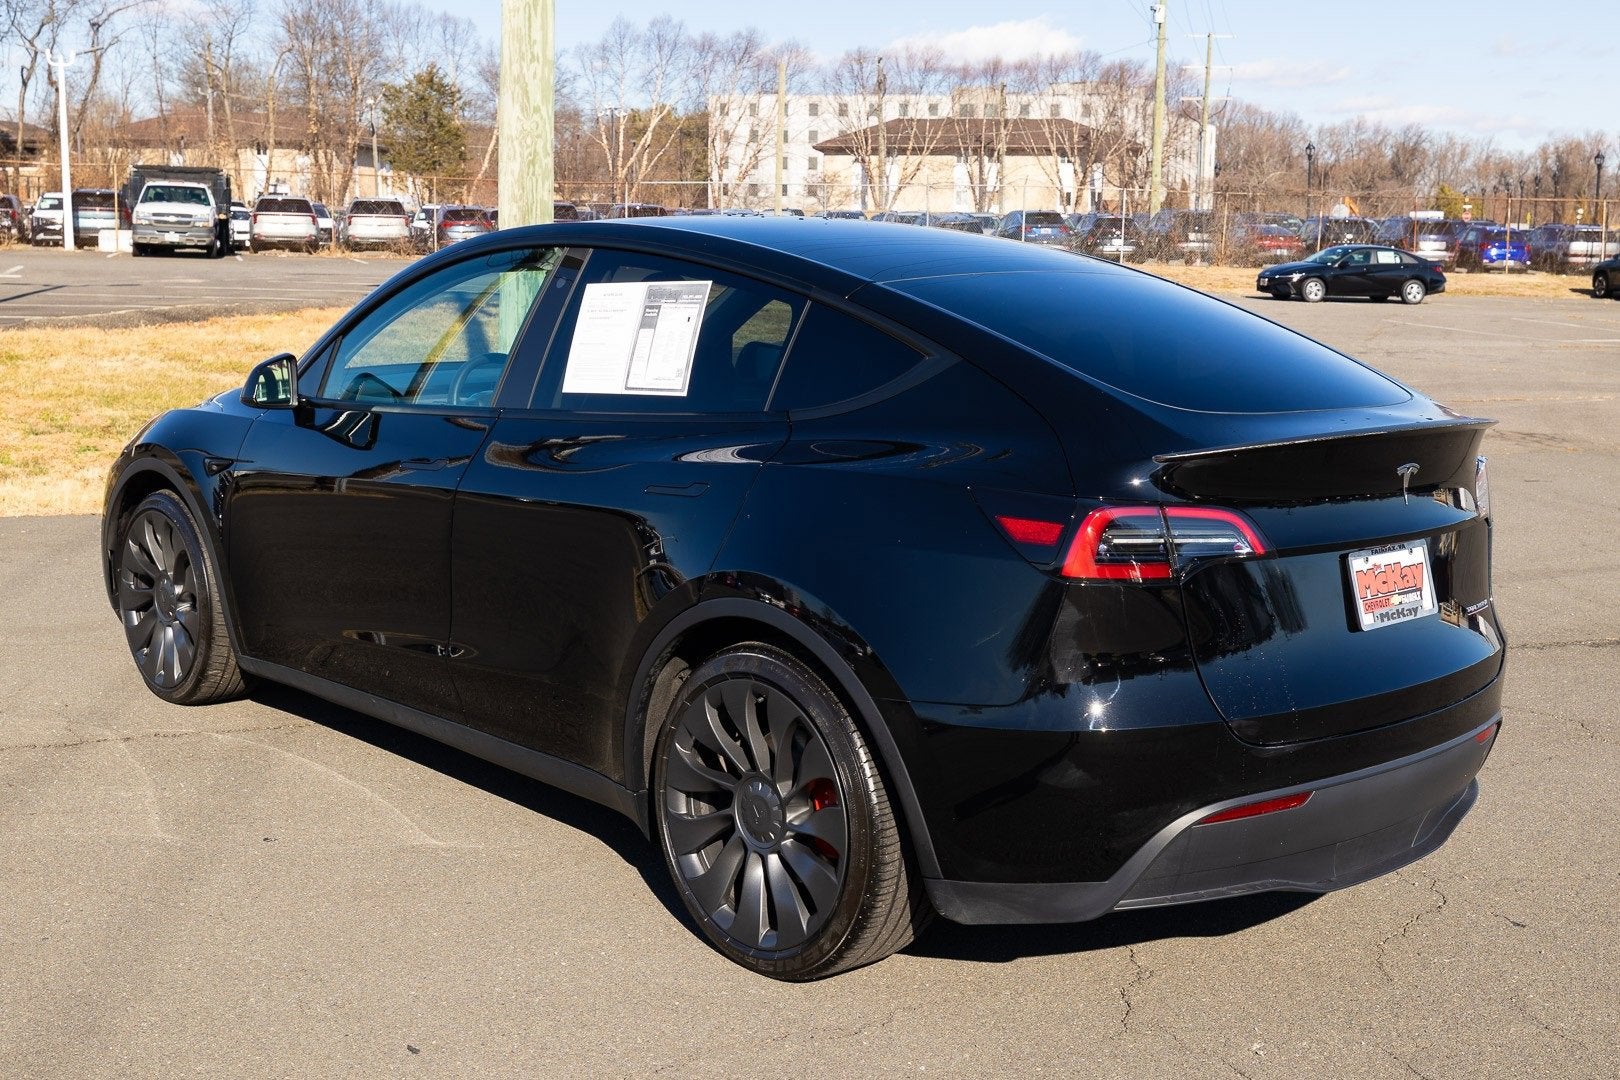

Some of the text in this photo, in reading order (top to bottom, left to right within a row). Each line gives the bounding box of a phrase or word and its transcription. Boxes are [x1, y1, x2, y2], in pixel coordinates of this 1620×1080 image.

[1356, 562, 1423, 600] McKay
[1364, 598, 1390, 612] CHEVROLET
[1379, 607, 1419, 623] McKay
